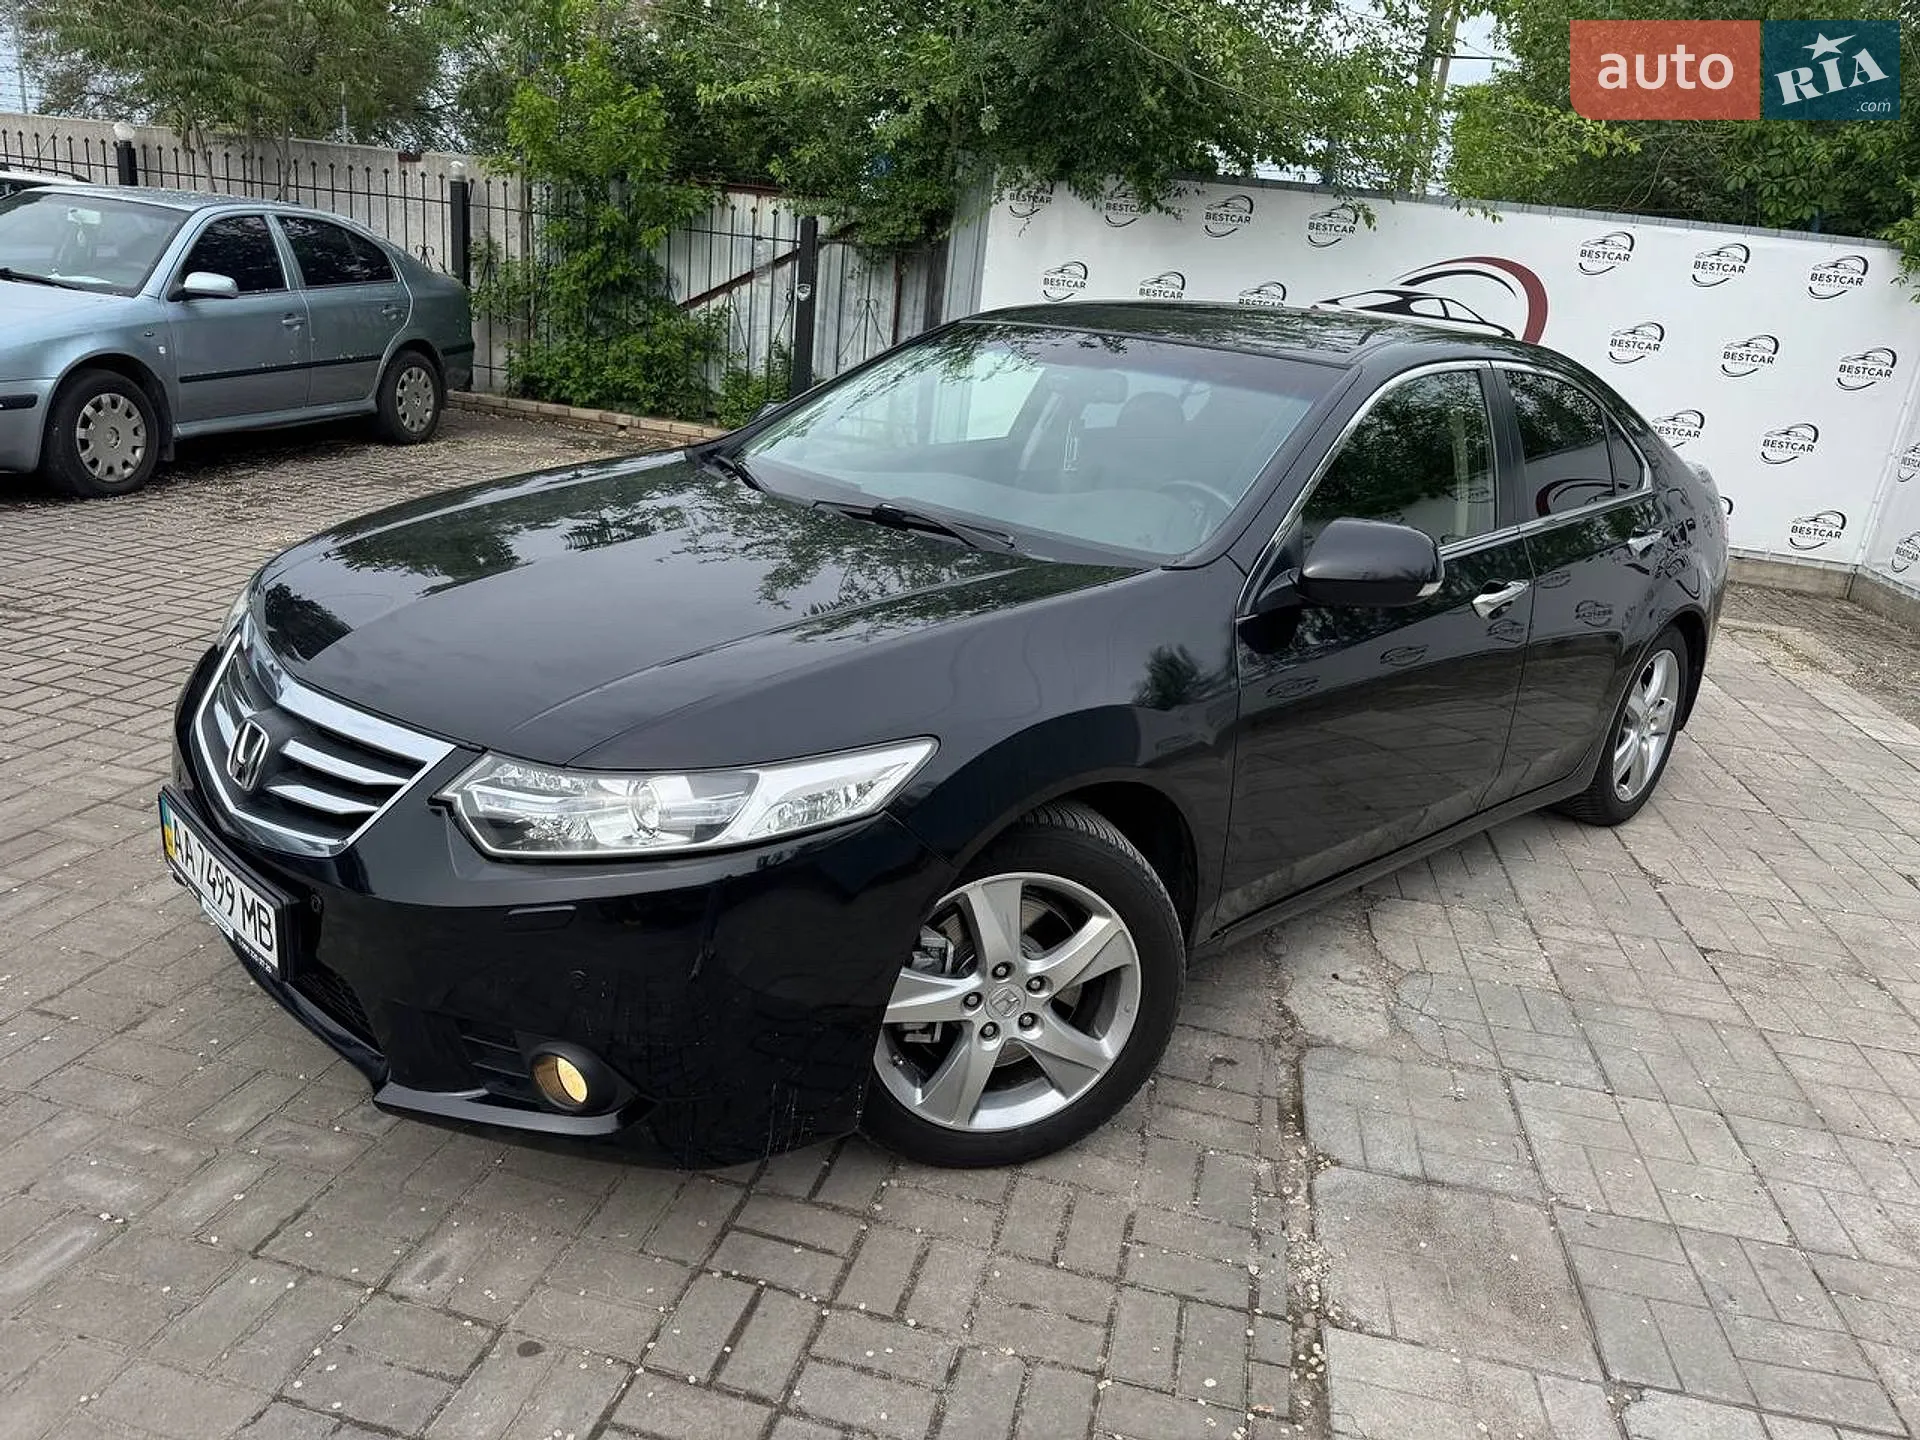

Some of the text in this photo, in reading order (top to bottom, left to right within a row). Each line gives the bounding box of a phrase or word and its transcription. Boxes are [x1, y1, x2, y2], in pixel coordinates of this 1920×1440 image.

[1204, 211, 1252, 225] BESTCAR
[1308, 222, 1356, 235] BESTCAR
[1579, 249, 1631, 262] BESTCAR
[1693, 260, 1746, 274] BESTCAR
[1043, 277, 1087, 289] BESTCAR
[1810, 272, 1865, 287] BESTCAR
[1138, 288, 1184, 300] BESTCAR
[1609, 337, 1662, 352] BESTCAR
[1723, 351, 1775, 365] BESTCAR
[1838, 364, 1893, 378] BESTCAR
[1762, 439, 1815, 453] BESTCAR
[1791, 525, 1842, 539] BESTCAR
[173, 818, 196, 879] AA
[197, 843, 235, 916] 7499
[240, 888, 274, 953] MB
